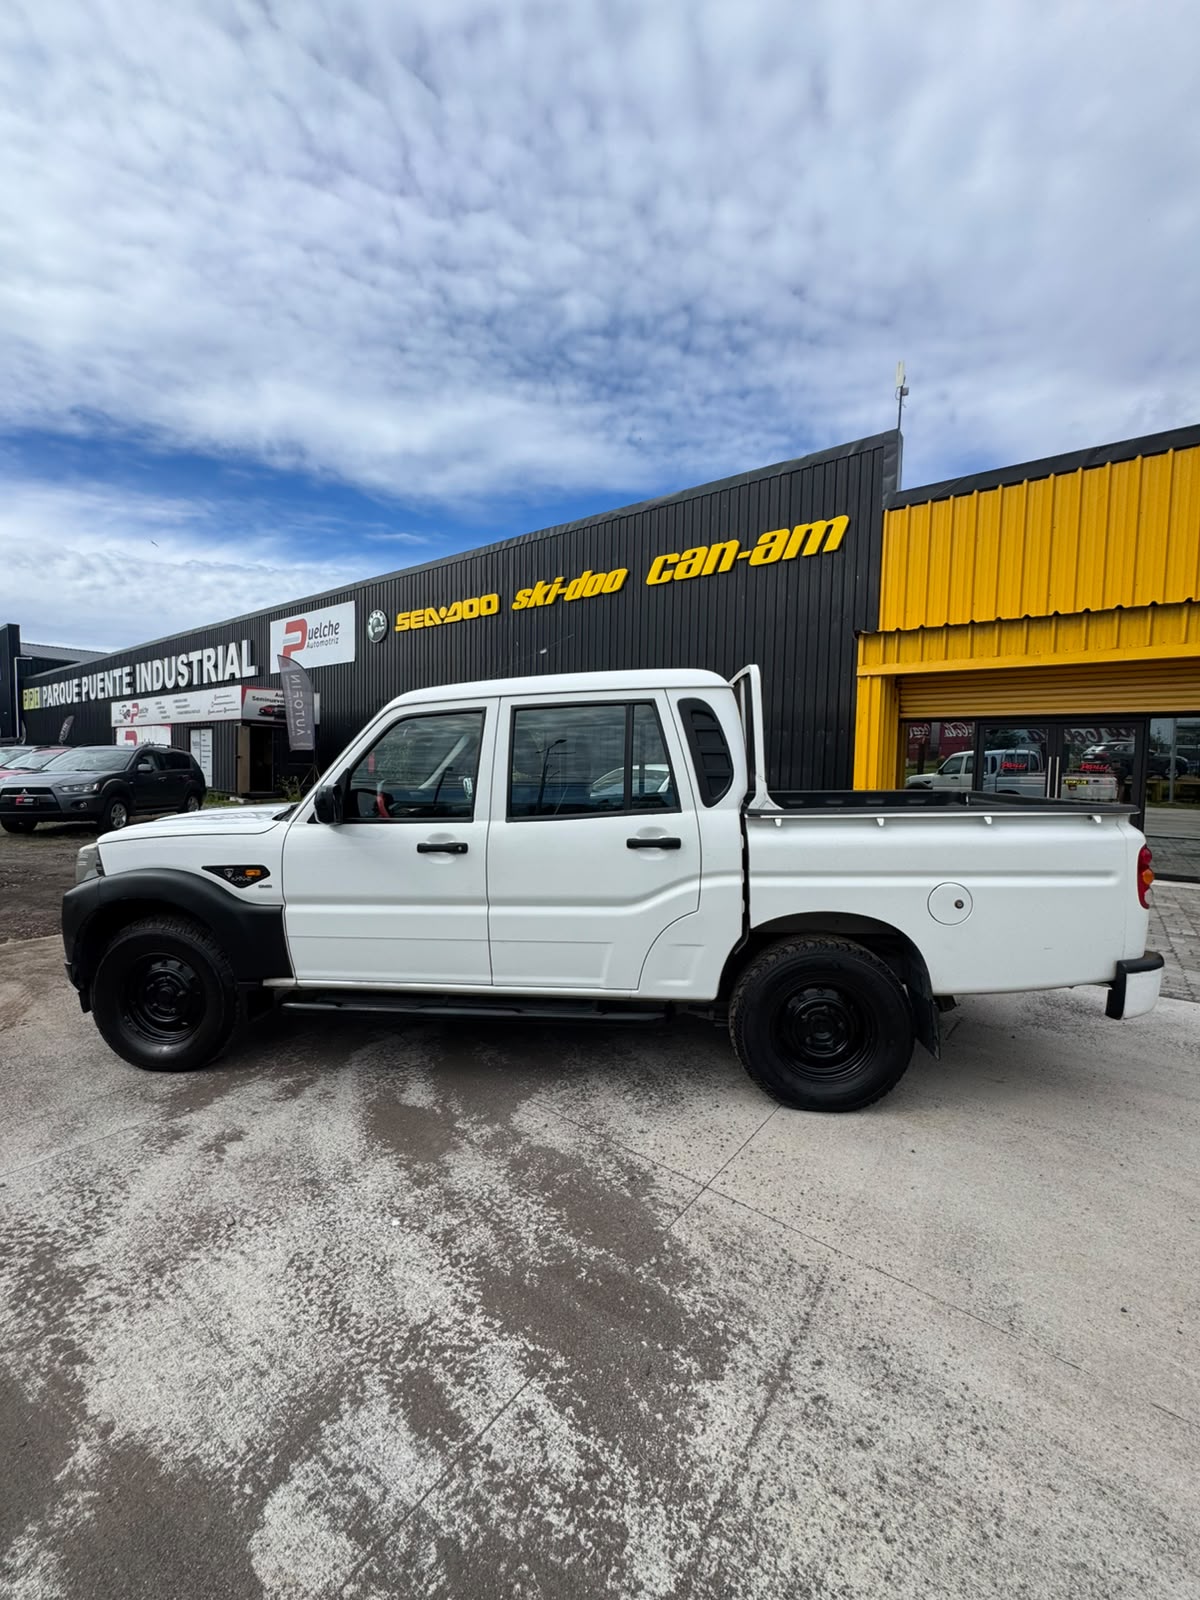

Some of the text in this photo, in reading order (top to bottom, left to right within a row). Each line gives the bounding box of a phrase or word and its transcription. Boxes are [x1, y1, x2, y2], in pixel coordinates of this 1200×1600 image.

[511, 568, 629, 610] ski-doo
[307, 637, 339, 649] Automotriz
[42, 678, 80, 708] PARQUE
[82, 667, 132, 702] PUENTE
[136, 639, 256, 695] INDUSTRIAL
